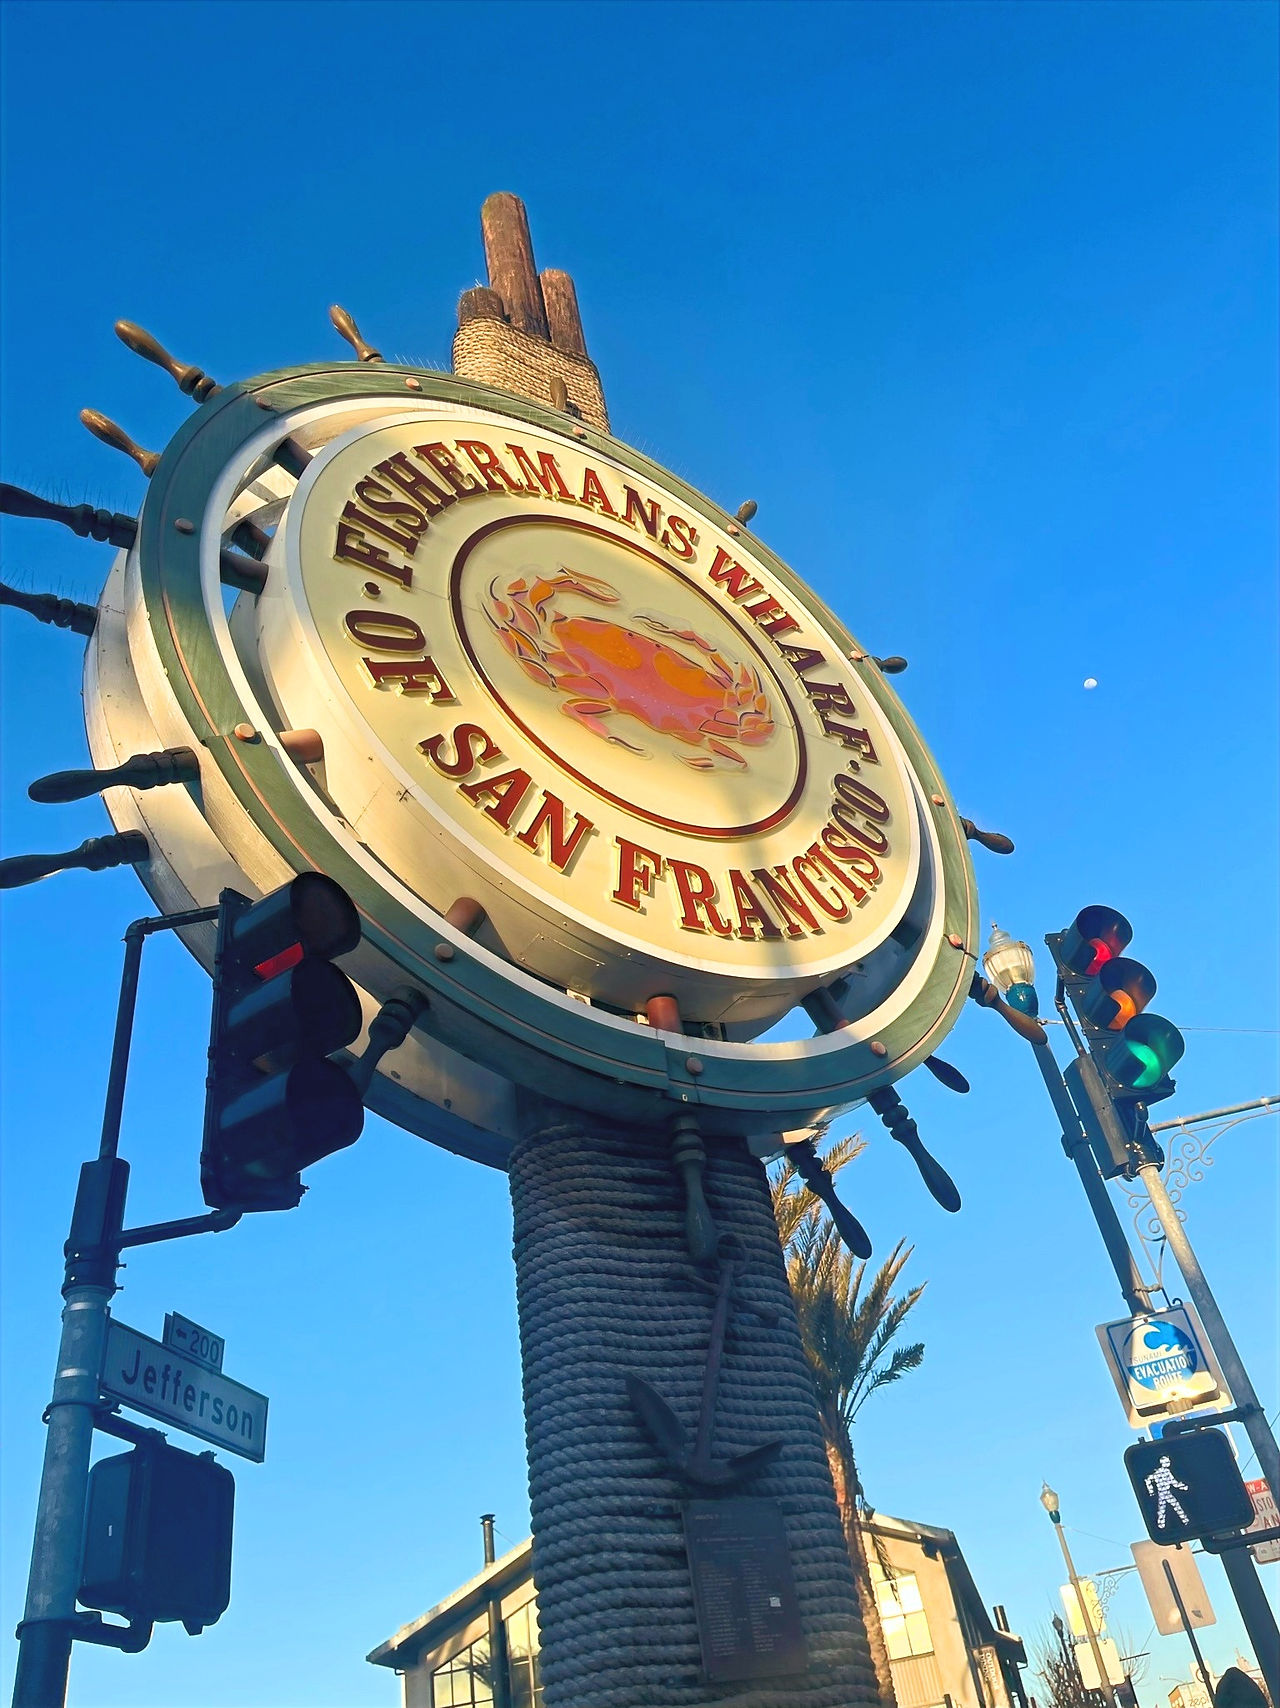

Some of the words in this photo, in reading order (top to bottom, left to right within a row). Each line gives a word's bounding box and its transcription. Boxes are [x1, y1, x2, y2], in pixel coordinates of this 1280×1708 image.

[333, 439, 701, 592] FISHERMANS
[707, 544, 879, 764] WHARF
[344, 609, 457, 704] OF
[416, 722, 594, 875] SAN
[609, 773, 891, 940] FRANCISCO
[190, 1330, 219, 1363] 200
[1134, 1355, 1193, 1380] EVACUATION
[1152, 1371, 1183, 1390] ROUTE
[121, 1349, 253, 1440] Jefferson
[1256, 1496, 1274, 1512] STO
[1264, 1514, 1280, 1528] AN
